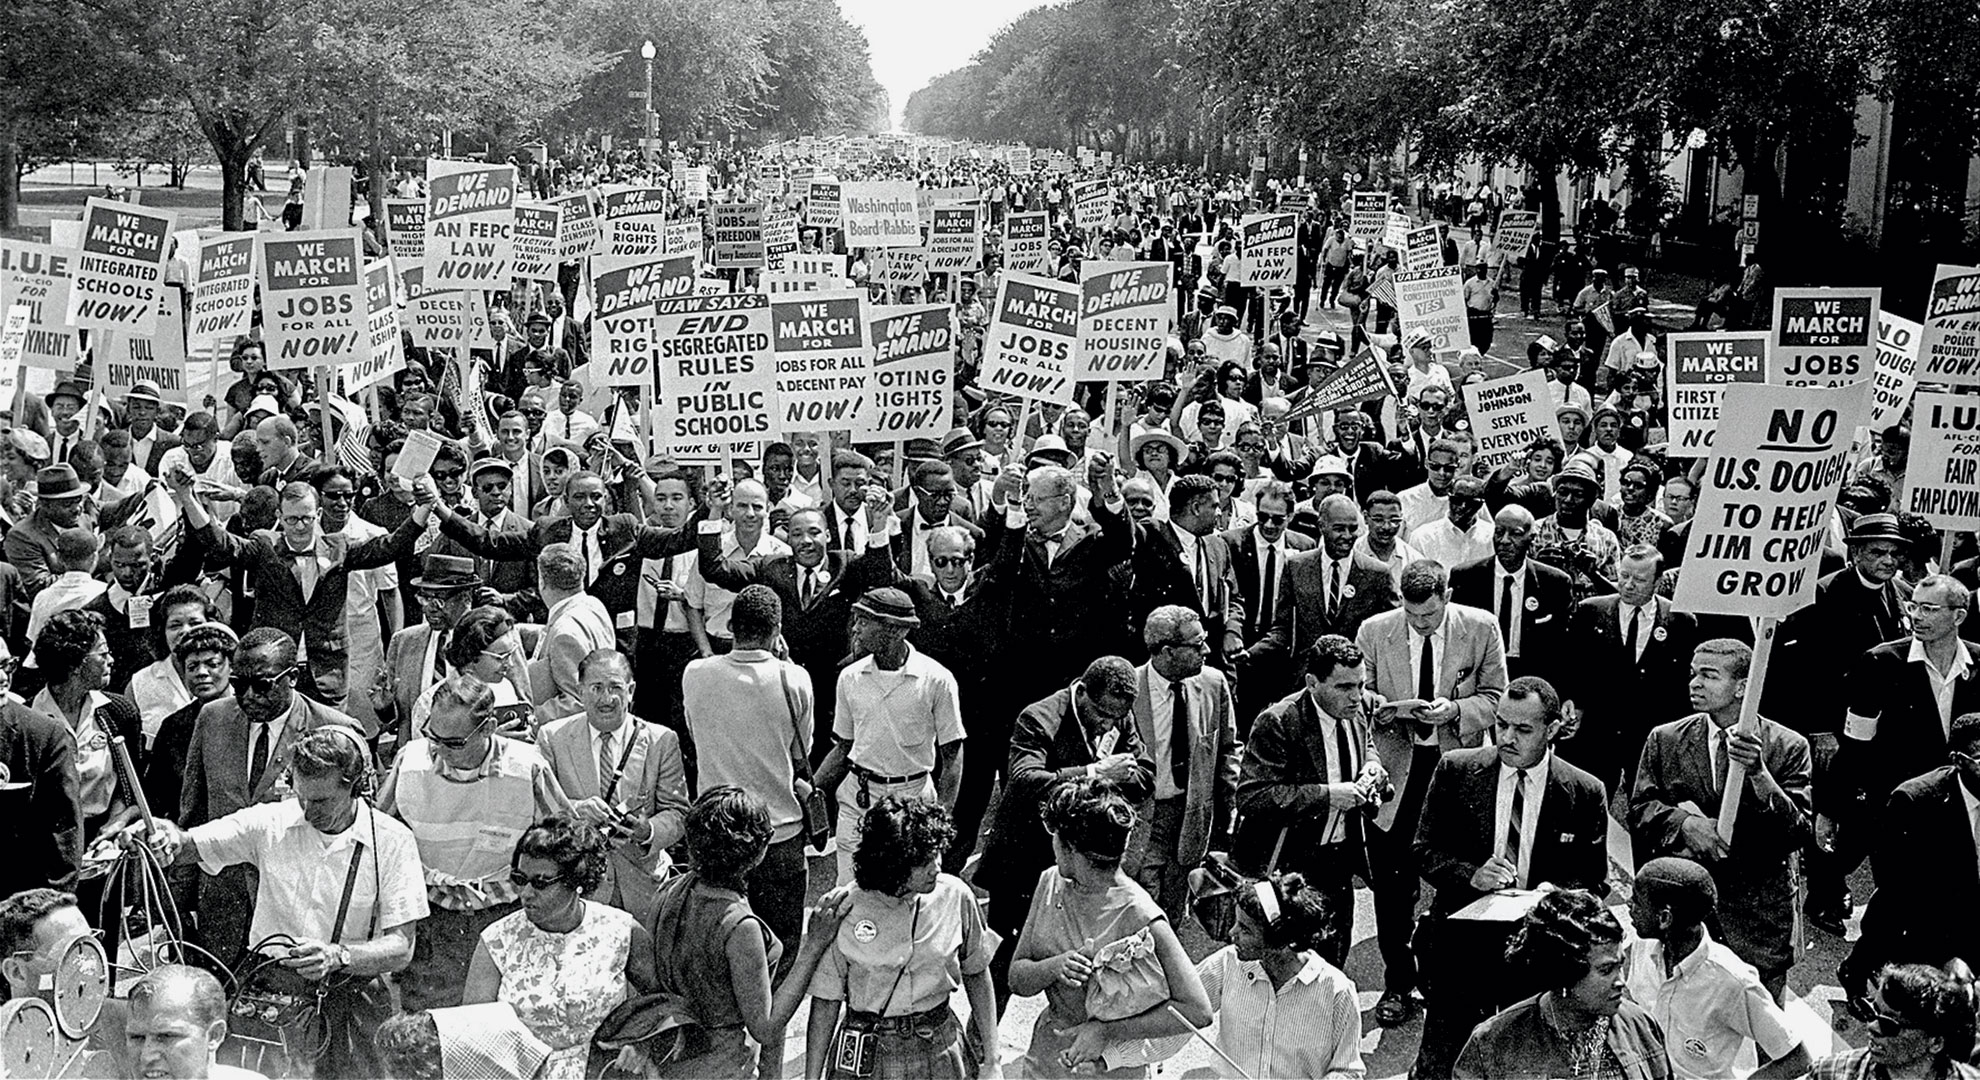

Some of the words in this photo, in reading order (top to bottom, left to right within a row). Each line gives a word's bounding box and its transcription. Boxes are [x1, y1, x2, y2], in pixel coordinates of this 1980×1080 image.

[457, 172, 489, 193] WE
[434, 187, 511, 216] DEMAND
[625, 191, 647, 203] WE
[811, 190, 839, 198] MARCH
[610, 200, 662, 217] DEMAND
[737, 206, 757, 214] SAYS
[809, 201, 841, 209] INTEGRATED
[810, 208, 840, 216] SCHOOLS
[847, 197, 913, 217] Washington
[1357, 200, 1384, 208] MARCH
[116, 213, 140, 229] WE
[524, 210, 540, 219] WE
[716, 216, 746, 228] JOBS
[747, 219, 760, 227] and
[811, 216, 838, 225] NOW!
[949, 210, 961, 218] WE
[1080, 213, 1108, 224] NOW!
[1354, 212, 1386, 220] INTEGRATED
[434, 222, 461, 238] AN
[469, 222, 511, 240] FEPC
[615, 221, 657, 233] EQUAL
[850, 219, 879, 236] Board
[884, 219, 916, 236] Rabbis
[936, 218, 972, 228] MARCH
[1011, 224, 1043, 232] MARCH
[1260, 218, 1281, 232] WE
[1354, 226, 1384, 235] NOW!
[91, 224, 159, 251] MARCH
[614, 233, 658, 244] RIGHTS
[716, 231, 760, 242] FREEDOM
[1246, 225, 1294, 246] DEMAND
[109, 245, 135, 257] FOR
[217, 243, 234, 255] WE
[297, 243, 325, 257] WE
[451, 241, 495, 258] LAW
[528, 245, 557, 256] RIGHTS
[611, 244, 658, 255] NOW!
[771, 245, 793, 253] THEY
[1011, 241, 1042, 252] JOBS
[1246, 249, 1263, 259] AN
[1267, 246, 1294, 257] FEPC
[1496, 243, 1526, 252] NOW!
[202, 252, 248, 273] MARCH
[514, 252, 541, 261] LAWS
[719, 251, 734, 261] Every
[735, 250, 761, 260] American
[898, 252, 923, 262] FEPC
[935, 255, 972, 267] NOW!
[1257, 258, 1285, 268] LAW
[80, 256, 158, 281] INTEGRATED
[274, 257, 350, 277] MARCH
[437, 260, 506, 280] NOW!
[1009, 258, 1043, 271] NOW!
[213, 269, 232, 278] FOR
[299, 277, 330, 286] FOR
[627, 262, 664, 287] WE
[1109, 269, 1143, 291] WE
[1250, 270, 1291, 282] NOW!
[1396, 272, 1421, 282] UAW
[1421, 266, 1459, 279] SAYS:
[20, 286, 47, 297] FOR
[77, 276, 154, 301] SCHOOLS
[196, 278, 249, 298] INTEGRATED
[600, 276, 692, 313] DEMAND
[195, 294, 248, 314] SCHOOLS
[660, 297, 705, 315] UAW
[707, 293, 763, 310] SAYS:
[1034, 288, 1059, 305] WE
[1086, 282, 1167, 314] DEMAND
[77, 299, 148, 325] NOW!
[277, 293, 353, 319] JOBS
[800, 303, 829, 319] WE
[1007, 298, 1077, 326] MARCH
[1415, 300, 1441, 316] YES
[1813, 301, 1841, 315] WE
[196, 310, 245, 334] NOW!
[282, 321, 314, 331] FOR
[324, 319, 352, 329] ALL
[677, 314, 750, 336] END
[779, 318, 855, 340] MARCH
[885, 313, 923, 339] WE
[1026, 317, 1054, 331] FOR
[1092, 318, 1159, 332] DECENT
[1786, 317, 1865, 334] MARCH
[1934, 318, 1960, 330] AN
[281, 331, 359, 359] NOW!
[662, 332, 769, 358] SEGREGATED
[802, 338, 833, 350] FOR
[1000, 332, 1070, 361] JOBS
[1085, 337, 1162, 352] HOUSING
[1809, 335, 1840, 345] FOR
[1942, 334, 1976, 347] POLICE
[129, 338, 154, 361] FULL
[1706, 342, 1734, 355] WE
[678, 355, 754, 378] RULES
[776, 359, 807, 373] JOBS
[810, 358, 837, 371] FOR
[840, 356, 866, 370] ALL
[999, 352, 1028, 366] FOR
[1036, 361, 1063, 373] ALL
[1088, 351, 1158, 372] NOW!
[1681, 355, 1759, 373] MARCH
[1783, 353, 1860, 377] JOBS
[788, 377, 836, 392] DECENT
[840, 375, 867, 390] PAY
[992, 367, 1066, 396] NOW!
[1705, 374, 1736, 382] FOR
[702, 381, 730, 392] IN
[1357, 381, 1387, 396] MARCH
[1477, 383, 1525, 402] HOWARD
[677, 391, 764, 415] PUBLIC
[1676, 390, 1717, 404] FIRST
[786, 395, 864, 423] NOW!
[674, 413, 769, 438] SCHOOLS
[1491, 412, 1528, 430] SERVE
[1766, 408, 1838, 445] NO
[1713, 456, 1761, 491] U.S.
[1769, 450, 1849, 494] DOUGH
[1944, 457, 1976, 485] FAIR
[1723, 503, 1763, 530] TO
[1770, 499, 1828, 532] HELP
[1695, 533, 1752, 561] JIM
[1762, 526, 1827, 563] CROW
[1716, 566, 1807, 598] GROW
